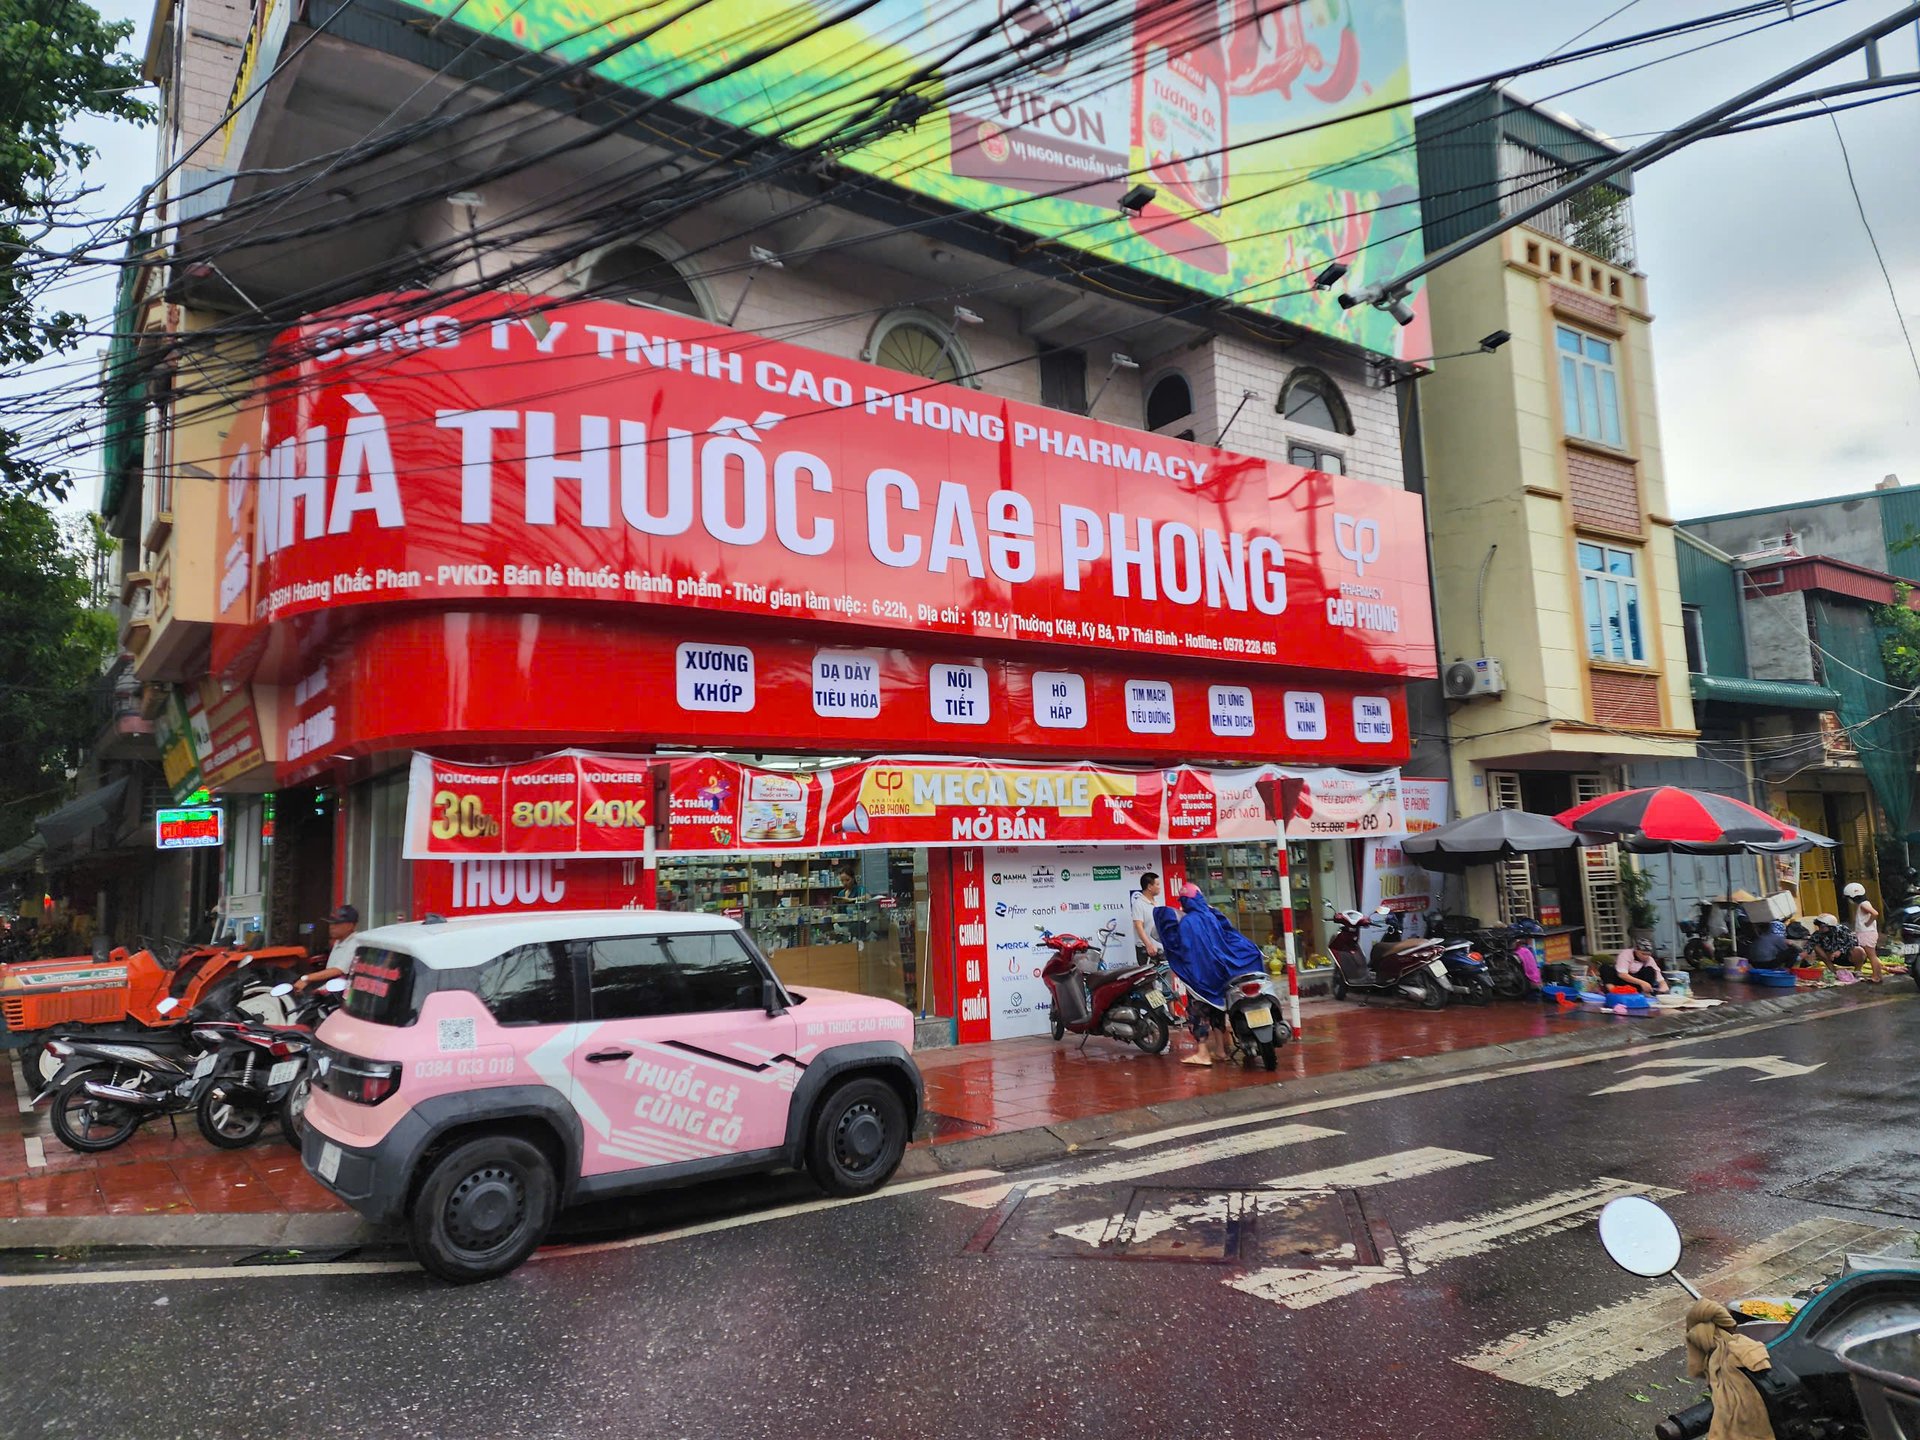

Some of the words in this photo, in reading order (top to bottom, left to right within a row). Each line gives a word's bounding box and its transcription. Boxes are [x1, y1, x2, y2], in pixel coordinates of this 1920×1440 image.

[988, 82, 1106, 145] VIFON
[1012, 140, 1026, 161] VỊ
[1028, 145, 1064, 165] NGON
[1065, 153, 1105, 176] CHUẨN
[490, 316, 568, 353] TY
[584, 324, 743, 384] TNHH
[755, 360, 853, 408] CAO
[865, 392, 1005, 442] PHONG
[1014, 422, 1208, 486] PHARMACY
[256, 392, 405, 566] NHÀ
[435, 408, 836, 557] THUỐC
[1060, 503, 1288, 616] PHONG
[1340, 581, 1384, 600] PHARMACY
[293, 579, 330, 601] Hoàng
[333, 567, 372, 594] Khắc
[375, 568, 421, 590] Phan
[437, 564, 499, 586] PVKD:
[503, 564, 542, 586] Bán
[546, 562, 563, 586] lẻ
[567, 564, 620, 589] thuốc
[624, 570, 673, 593] thành
[676, 571, 722, 599] phẩm
[733, 582, 766, 604] Thời
[770, 588, 801, 610] gian
[805, 590, 830, 611] làm
[872, 599, 913, 622] 6-22h,
[918, 605, 938, 626] Địa
[971, 609, 992, 628] 132
[994, 614, 1009, 633] Lý
[1011, 614, 1053, 637] Thường
[1056, 618, 1081, 639] Kiệt,
[1082, 622, 1095, 641] Kỳ
[1117, 626, 1130, 641] TP
[1132, 627, 1154, 644] Thái
[1156, 630, 1178, 647] Bình
[1223, 640, 1245, 653] 0978
[1246, 640, 1261, 654] 228
[1357, 602, 1398, 633] PHONG
[685, 649, 749, 675] XƯƠNG
[821, 662, 841, 683] DẠ
[845, 659, 871, 682] DÀY
[693, 678, 743, 704] KHỚP
[947, 669, 973, 693] NỘI
[1052, 679, 1068, 699] HÔ
[815, 689, 846, 708] TIÊU
[851, 688, 879, 710] HÓA
[945, 694, 975, 718] TIẾT
[1132, 688, 1145, 702] TIM
[1146, 688, 1168, 705] MẠCH
[1217, 693, 1227, 710] DỊ
[1228, 690, 1245, 708] ỨNG
[1050, 698, 1073, 721] HẤP
[1132, 704, 1148, 724] TIỂU
[1148, 709, 1171, 725] ĐƯỜNG
[1212, 709, 1233, 728] MIỄN
[1235, 715, 1254, 731] DỊCH
[1297, 720, 1317, 733] KINH
[1357, 719, 1372, 735] TIẾT
[436, 773, 499, 785] VOUCHER
[512, 773, 576, 785] VOUCHER
[583, 772, 643, 784] VOUCHER
[669, 793, 682, 809] ỐC
[912, 774, 1008, 806] MEGA
[1016, 774, 1089, 806] SALE
[511, 799, 576, 828] 80K
[583, 799, 647, 828] 40K
[887, 804, 910, 815] PHONG
[1104, 797, 1133, 809] THÁNG
[431, 790, 499, 840] 30%
[692, 811, 733, 824] THƯỞNG
[952, 806, 992, 840] MỞ
[998, 804, 1046, 840] BÁN
[1172, 811, 1194, 826] MIỄN
[1195, 811, 1211, 826] PHÍ
[962, 880, 980, 909] VẤN
[1008, 905, 1028, 919] Pfizer
[1032, 906, 1057, 916] sanofi
[1103, 903, 1125, 911] STELLA
[958, 915, 985, 946] CHUẨN
[966, 960, 980, 983] GIA
[962, 989, 988, 1021] CHUẨN
[415, 1060, 453, 1078] 0384
[457, 1057, 484, 1077] 033
[489, 1056, 515, 1074] 018
[624, 1057, 707, 1103] THUỐC
[706, 1084, 740, 1114] GÌ
[634, 1093, 707, 1135] CŨNG
[706, 1115, 744, 1146] CÓ
